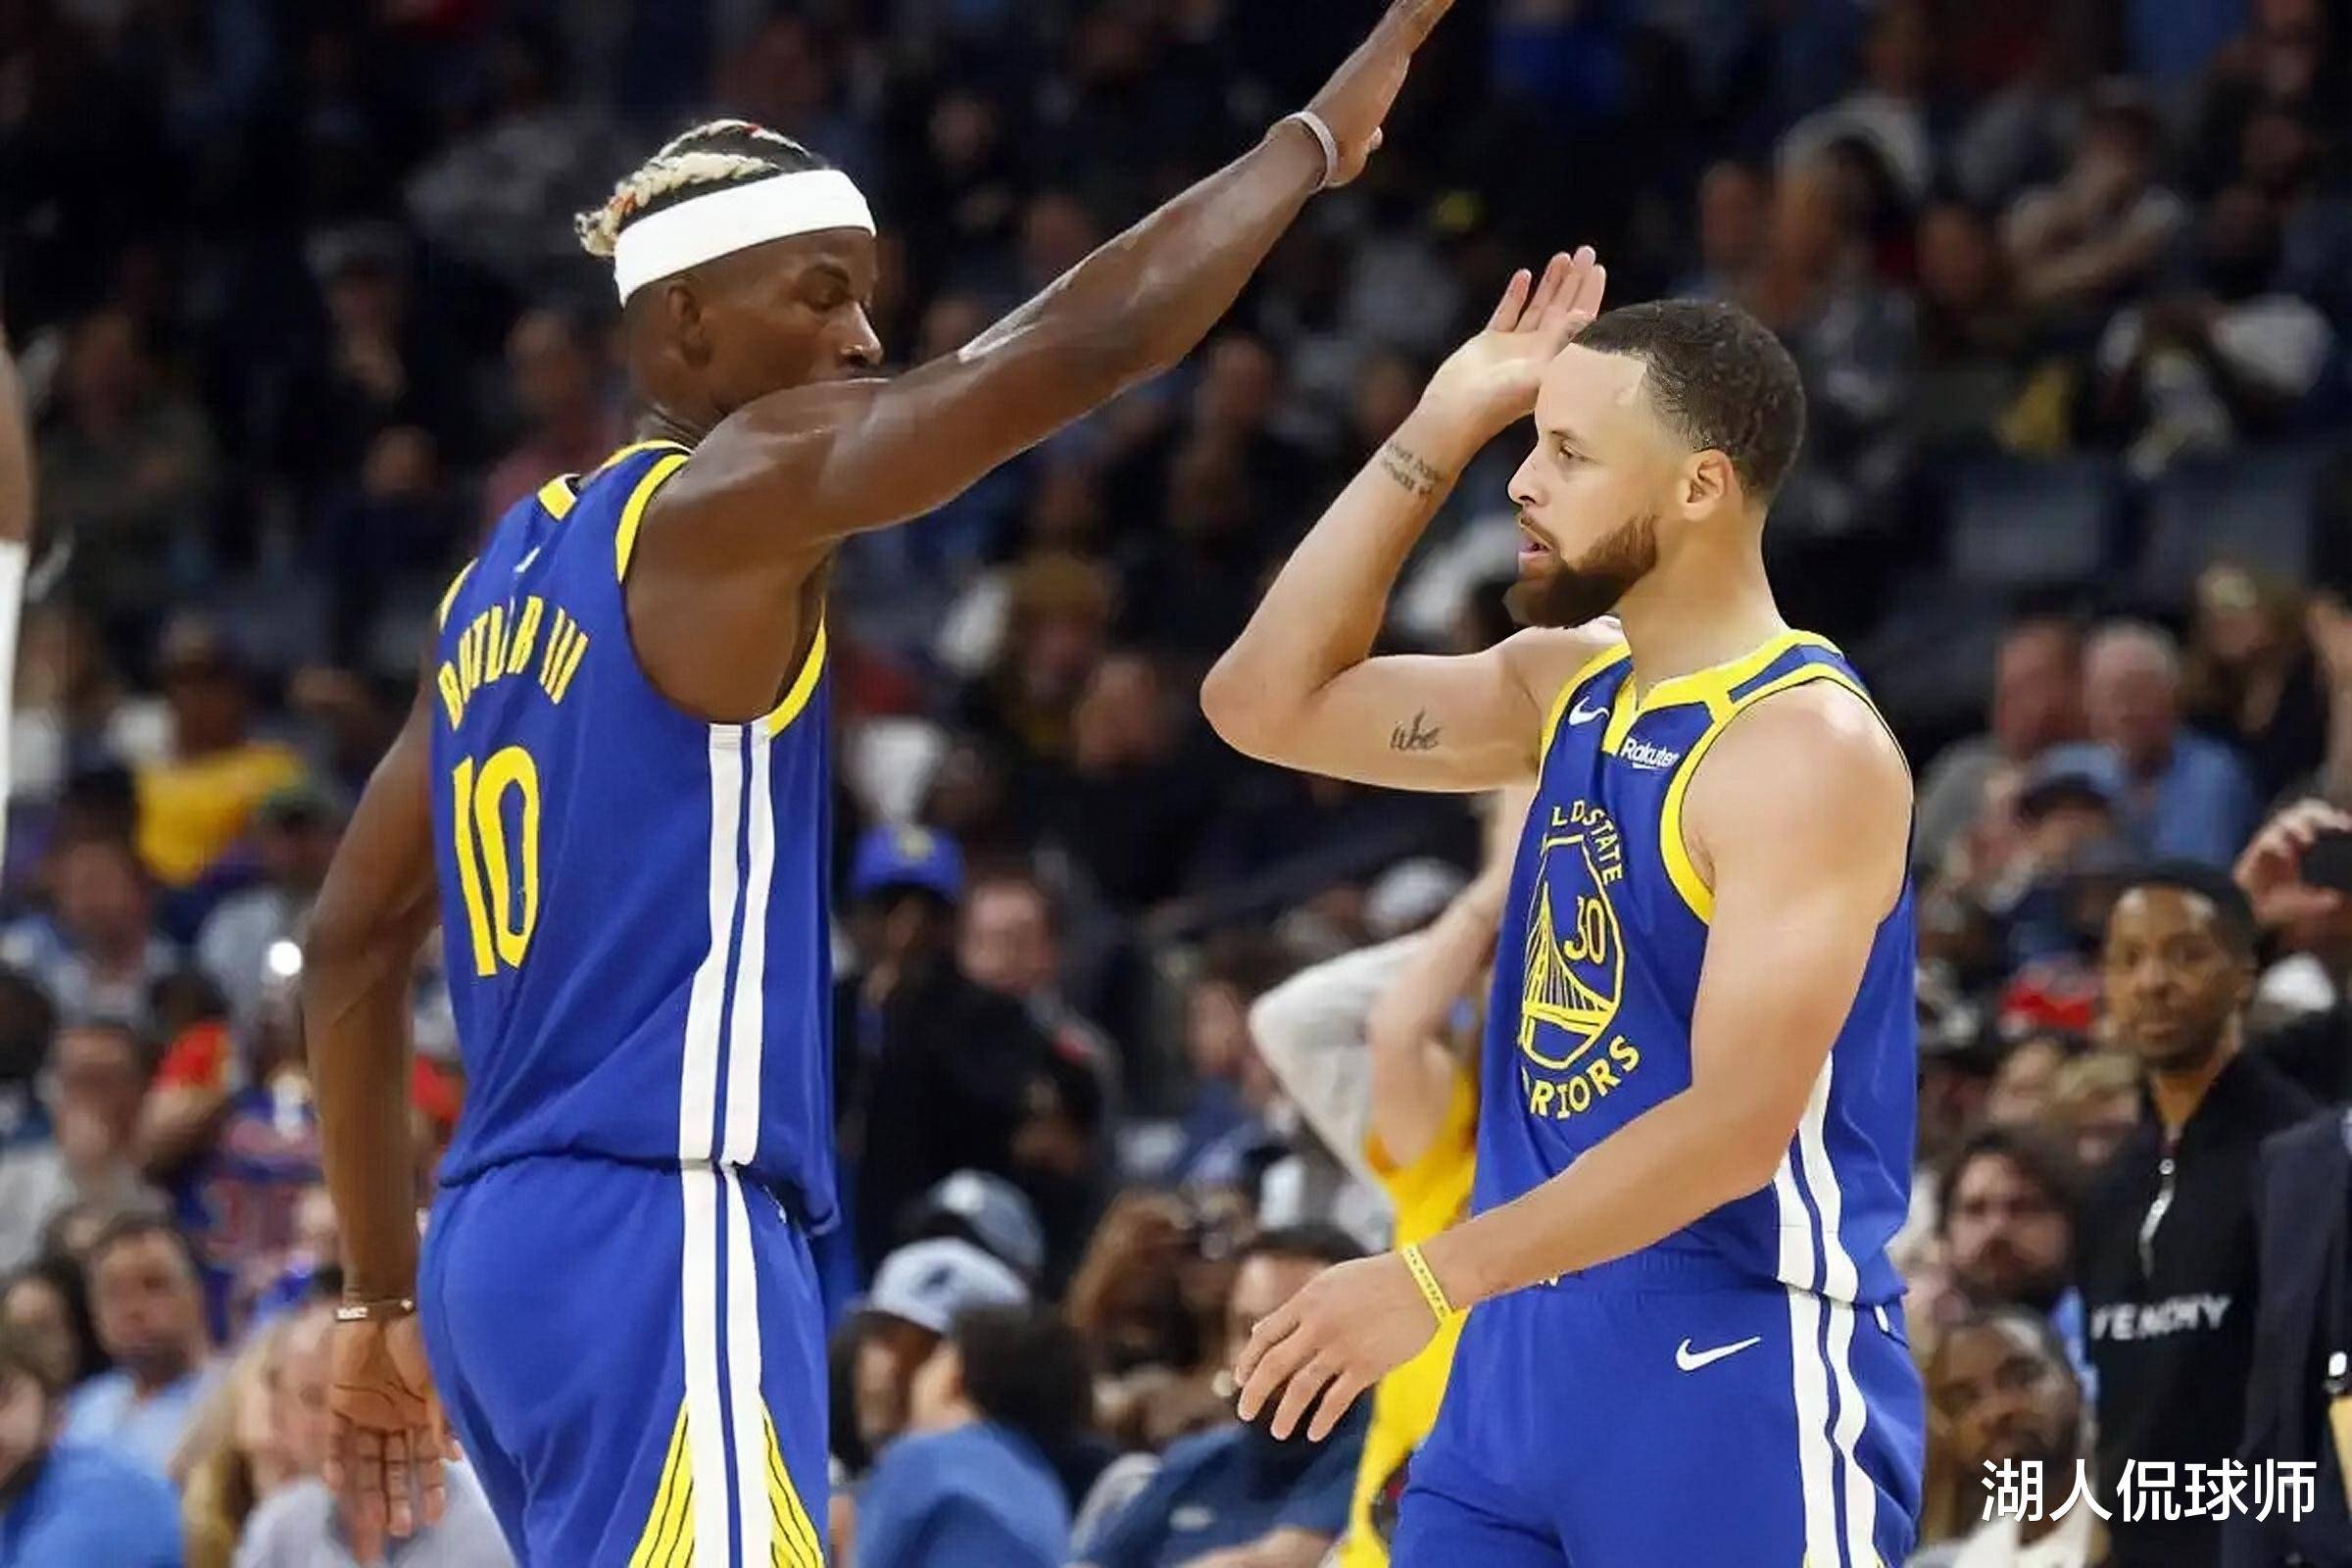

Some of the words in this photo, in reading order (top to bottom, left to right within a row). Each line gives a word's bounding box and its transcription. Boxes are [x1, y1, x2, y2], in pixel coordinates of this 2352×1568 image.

[438, 595, 544, 732] BUTLR
[452, 745, 539, 977] 10
[1563, 894, 1606, 965] 30
[1522, 1035, 1641, 1119] RIORS
